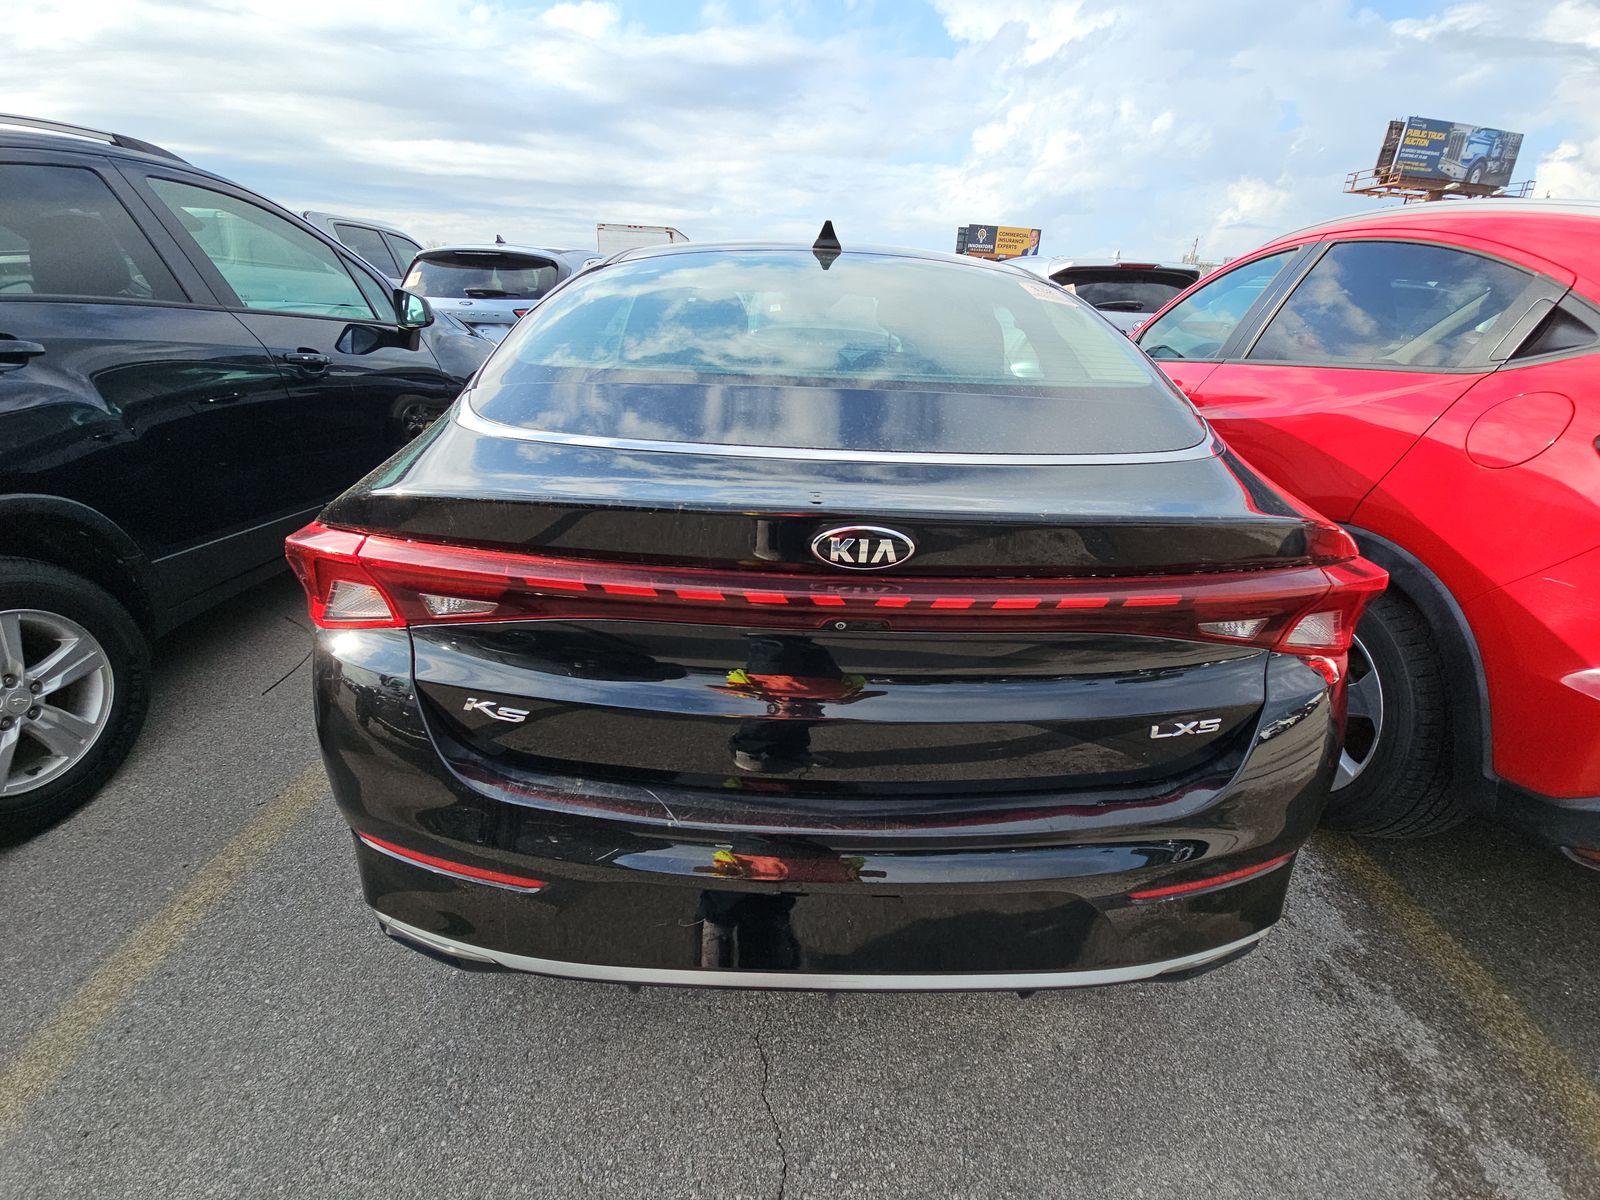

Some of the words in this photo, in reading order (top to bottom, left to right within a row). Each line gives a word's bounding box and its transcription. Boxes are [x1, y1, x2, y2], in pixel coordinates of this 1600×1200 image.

[1404, 137, 1430, 147] AUCTION
[1407, 129, 1428, 137] PUBLIC
[1428, 131, 1447, 140] TRUCK
[999, 231, 1029, 239] COMMERCIAL
[829, 536, 897, 563] KIA
[463, 697, 530, 723] K5
[1150, 718, 1222, 739] LXS
